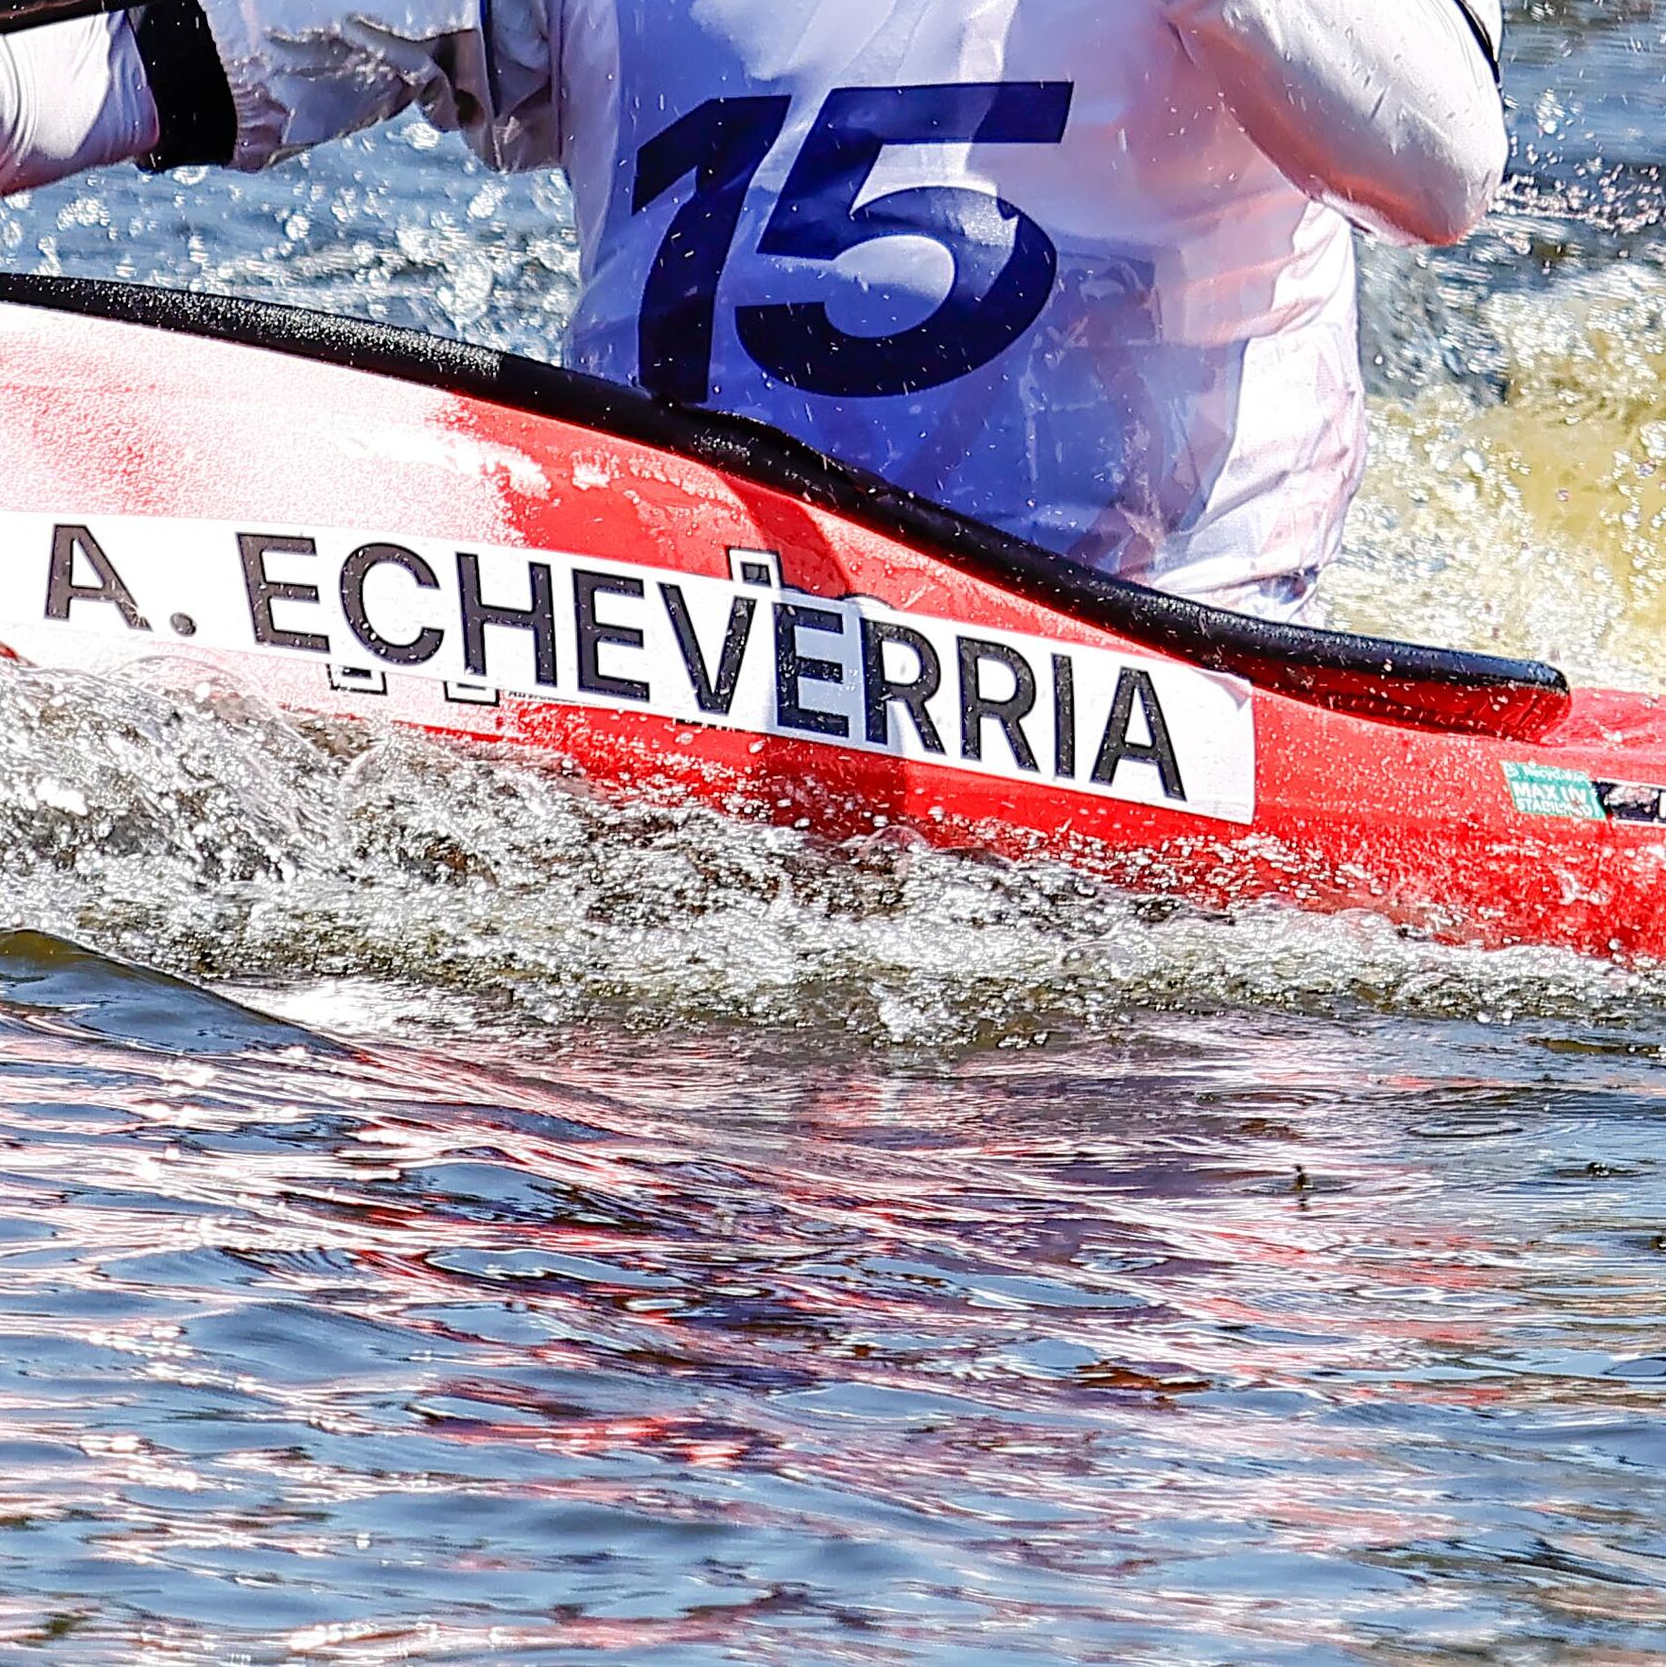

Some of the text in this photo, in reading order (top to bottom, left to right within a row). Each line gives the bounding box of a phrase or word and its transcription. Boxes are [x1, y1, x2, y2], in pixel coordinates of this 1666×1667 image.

[632, 81, 1074, 403] 15
[43, 522, 1187, 801] A. ECHEVERRIA
